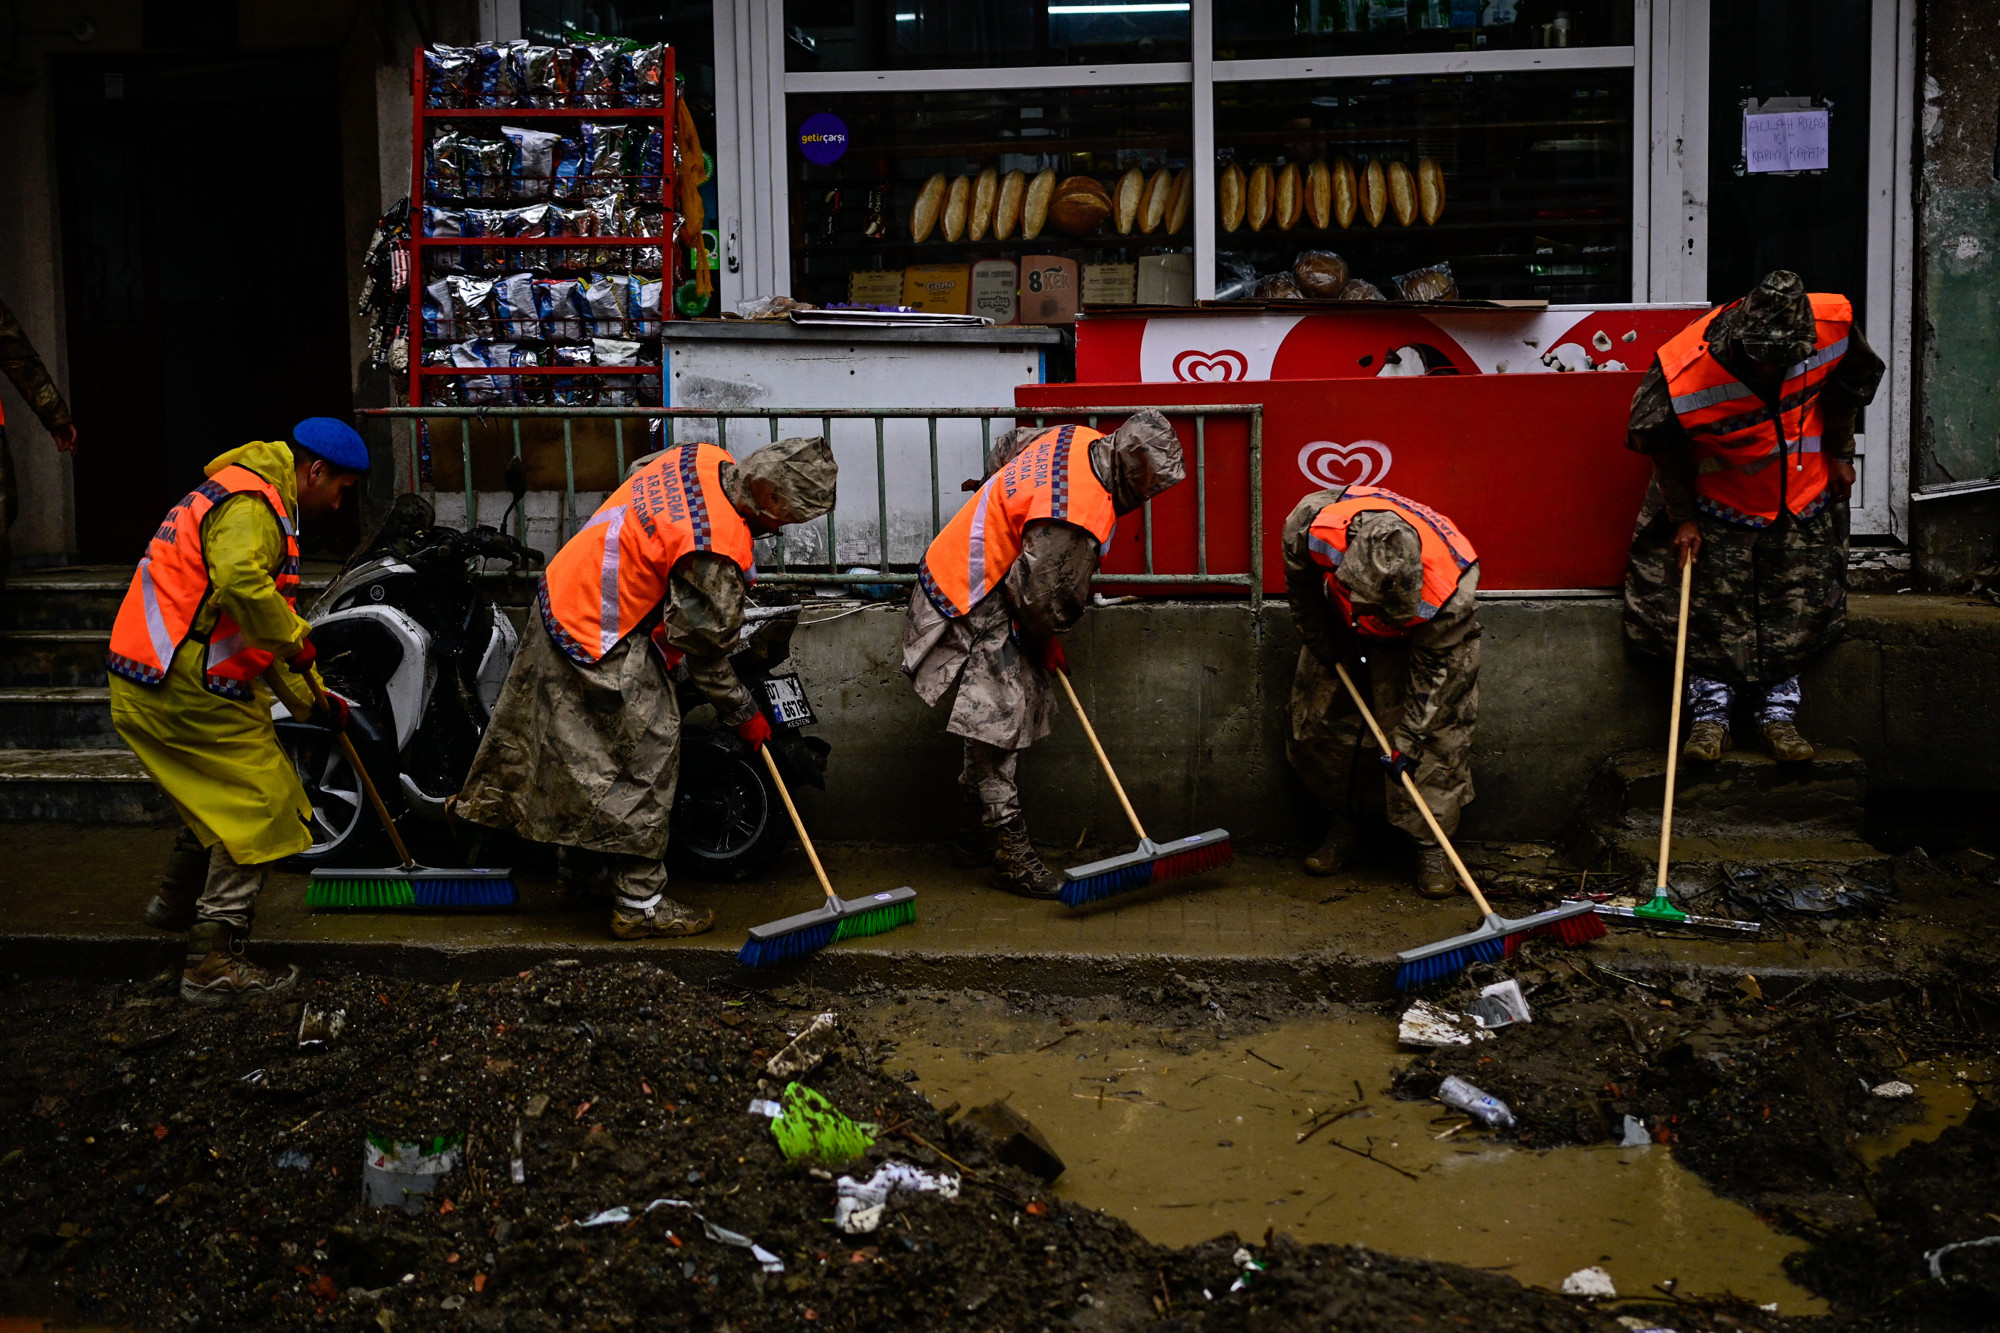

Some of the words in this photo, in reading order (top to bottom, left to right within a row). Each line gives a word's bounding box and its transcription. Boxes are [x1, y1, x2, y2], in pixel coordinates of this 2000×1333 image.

[1749, 117, 1793, 132] ALLAH
[632, 476, 656, 539] KURTARMA
[647, 474, 665, 516] ARAMA
[661, 461, 686, 524] JANDARMA
